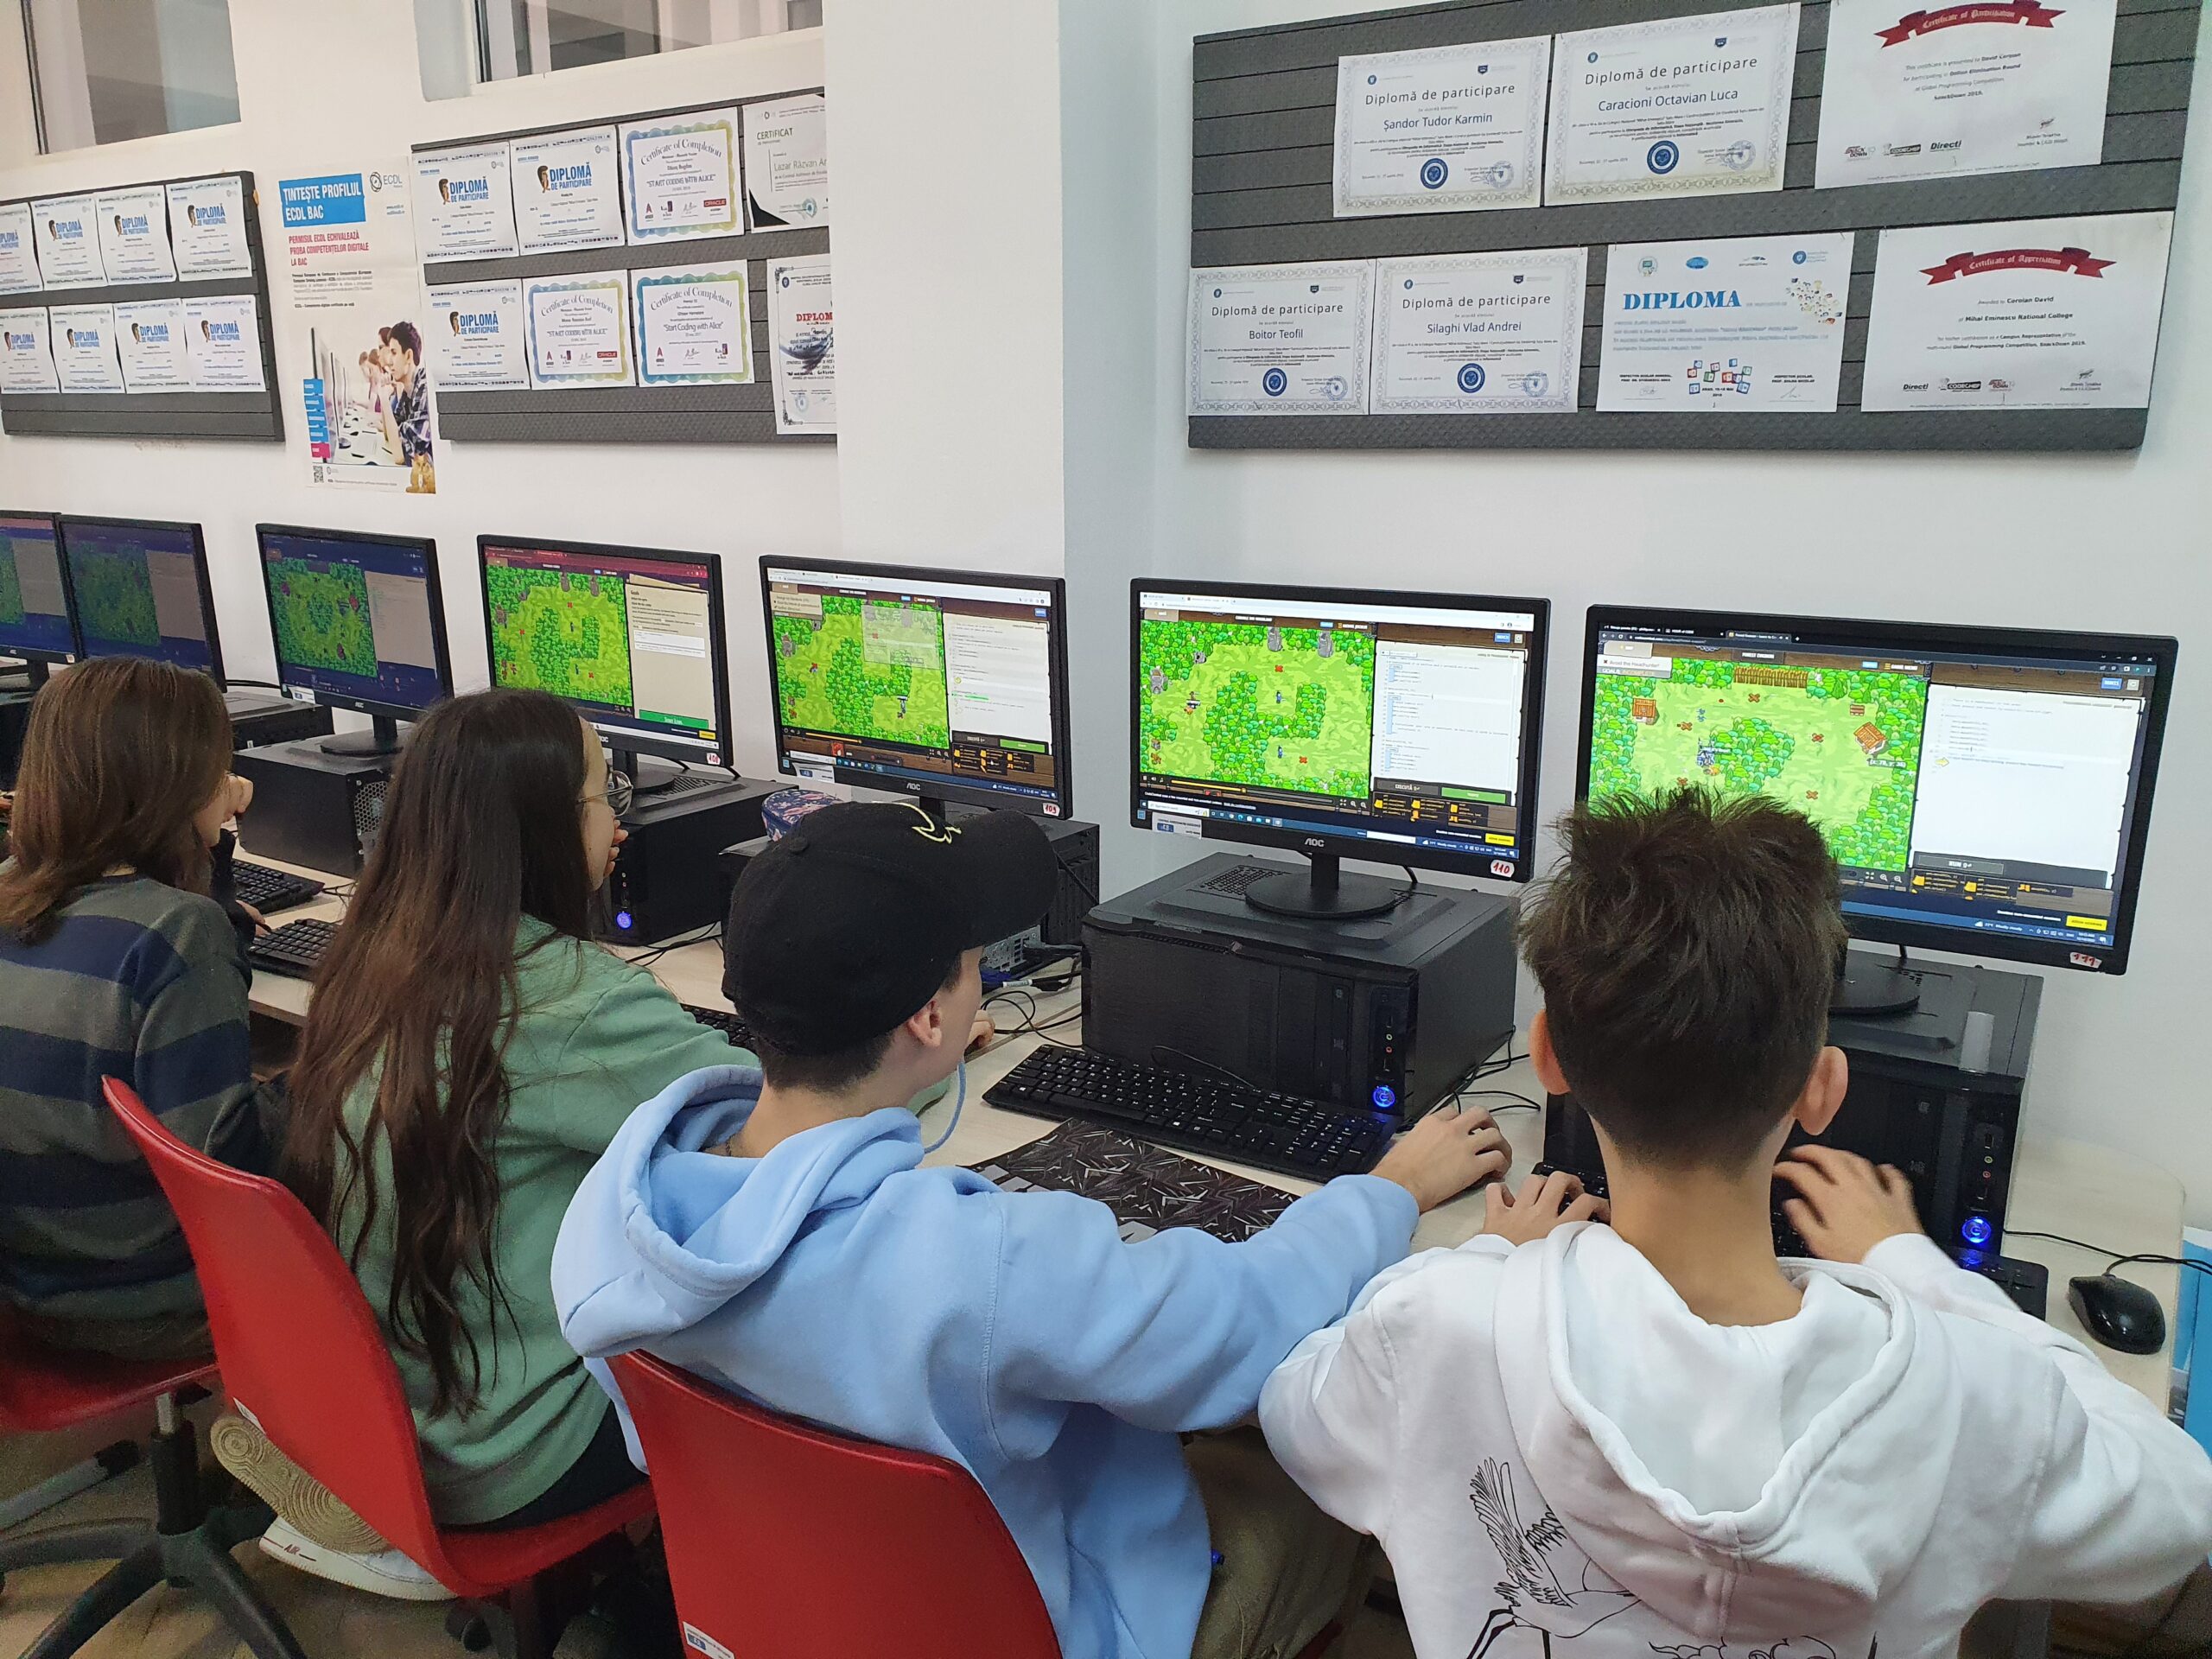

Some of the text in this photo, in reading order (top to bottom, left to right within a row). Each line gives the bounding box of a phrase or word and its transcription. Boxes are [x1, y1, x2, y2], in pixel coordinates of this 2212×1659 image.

[1586, 57, 1758, 86] Diplomă de participare
[1365, 85, 1515, 106] Diplomă de participare
[1599, 89, 1738, 111] Caracioni Octavian Luca
[1384, 113, 1492, 131] Șandor Tudor Karmin
[757, 128, 793, 141] CERTIFICAT
[640, 138, 721, 165] Certificate of Completion
[550, 162, 592, 181] DIPLOMĂ
[774, 160, 792, 171] Lazar
[384, 175, 403, 185] ECDL
[449, 176, 488, 194] DIPLOMĂ
[551, 178, 592, 191] DE PARTICIPARE
[322, 182, 361, 198] PROFILUL
[459, 192, 489, 202] PARTICIPARE
[196, 203, 226, 219] DIPLOMĂ
[286, 205, 324, 221] ECDL BAC
[56, 219, 82, 233] DIPLOMĂ
[122, 214, 149, 229] DIPLOMĂ
[289, 234, 313, 244] PERMISUL
[327, 230, 359, 242] ECHIVALEAZĂ
[290, 246, 305, 255] PROBA
[347, 243, 369, 251] DIGITALE
[2007, 255, 2015, 264] of
[541, 299, 570, 316] Certificate
[571, 296, 578, 304] of
[579, 295, 613, 315] Completion
[651, 290, 682, 311] Certificate
[683, 288, 690, 297] of
[692, 286, 733, 308] Completion
[1402, 295, 1551, 311] Diplomă de participare
[1623, 290, 1742, 310] DIPLOMA
[796, 312, 832, 321] DIPLOM
[1212, 303, 1344, 318] Diplomă de participare
[460, 311, 498, 327] DIPLOMĂ
[140, 322, 168, 335] DIPLOMĂ
[210, 321, 239, 334] DIPLOMĂ
[468, 324, 499, 334] PARTICIPARE
[677, 323, 696, 332] Coding
[1249, 329, 1303, 340] Boitor Teofil
[1427, 321, 1522, 335] Silaghi Vlad Andrei
[1305, 837, 1325, 847] AOC
[1493, 862, 1510, 874] 110
